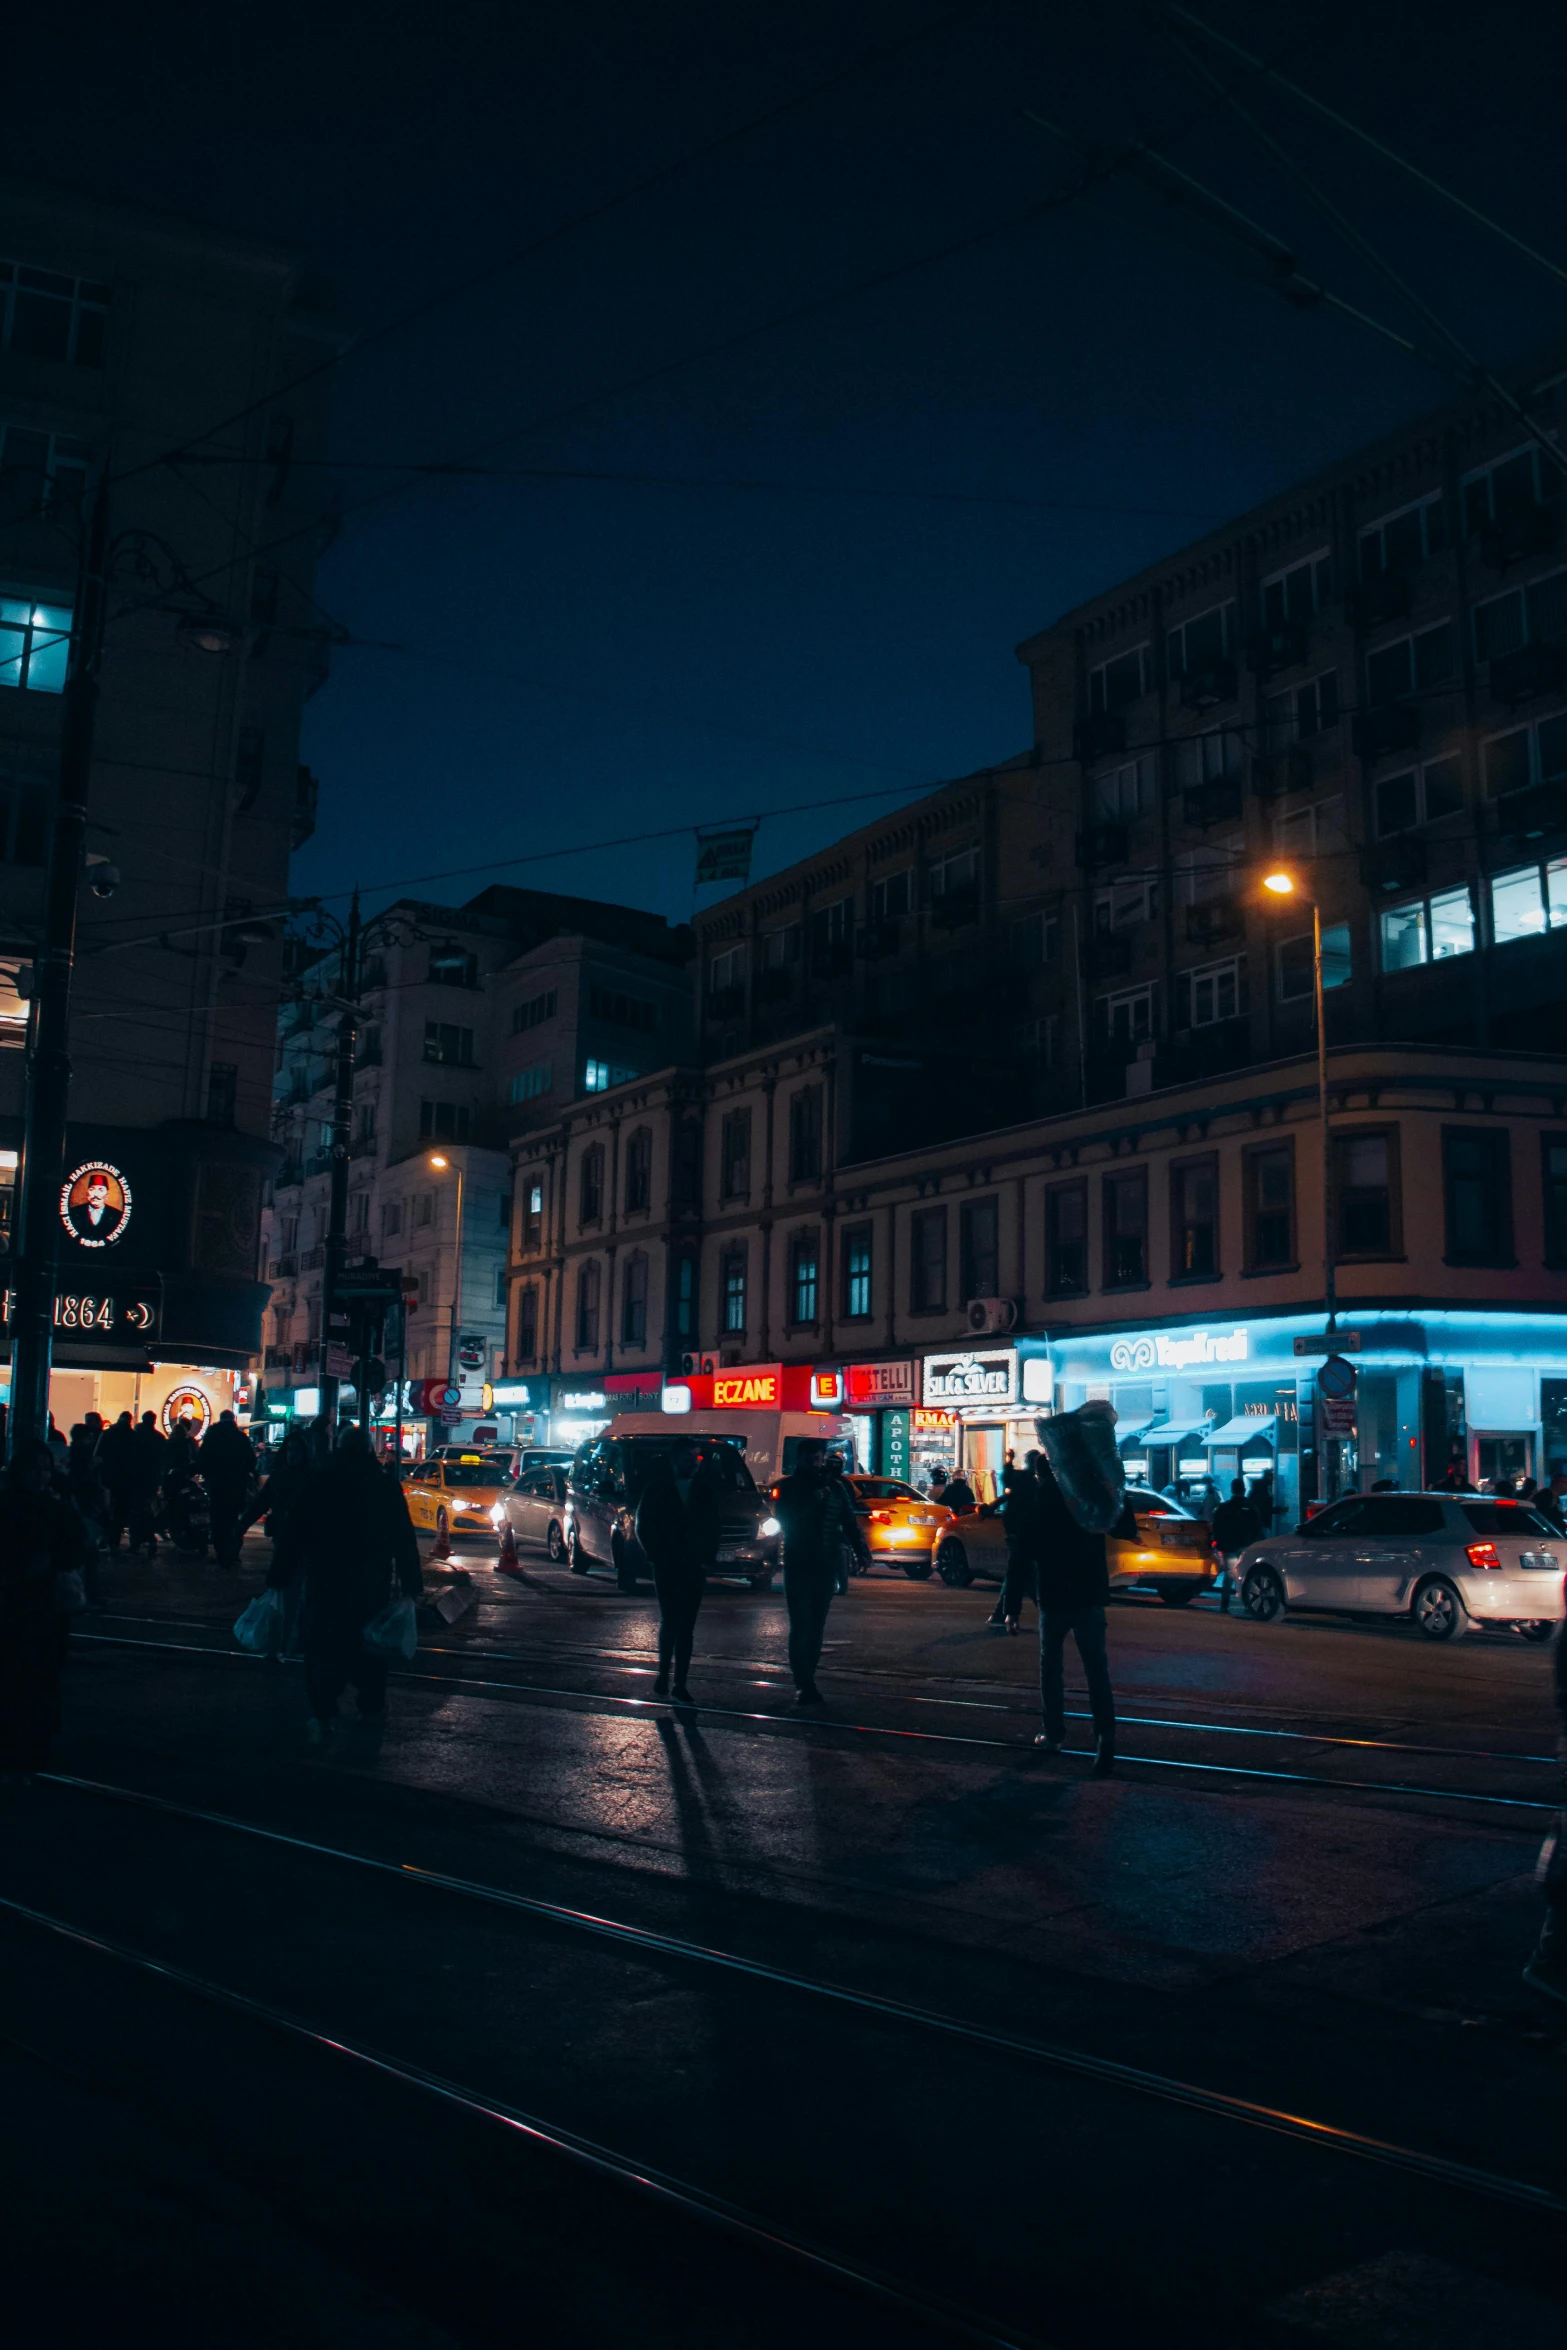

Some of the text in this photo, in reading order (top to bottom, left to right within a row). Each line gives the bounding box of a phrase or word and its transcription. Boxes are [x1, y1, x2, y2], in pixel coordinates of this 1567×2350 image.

[69, 1161, 120, 1182] HAKKIZADE
[117, 1176, 132, 1205] HAFIZ
[106, 1204, 132, 1242] MUSTAFA
[53, 1293, 115, 1330] 1864
[638, 1391, 659, 1401] SONY
[714, 1377, 776, 1404] ECZANE
[820, 1376, 834, 1395] E
